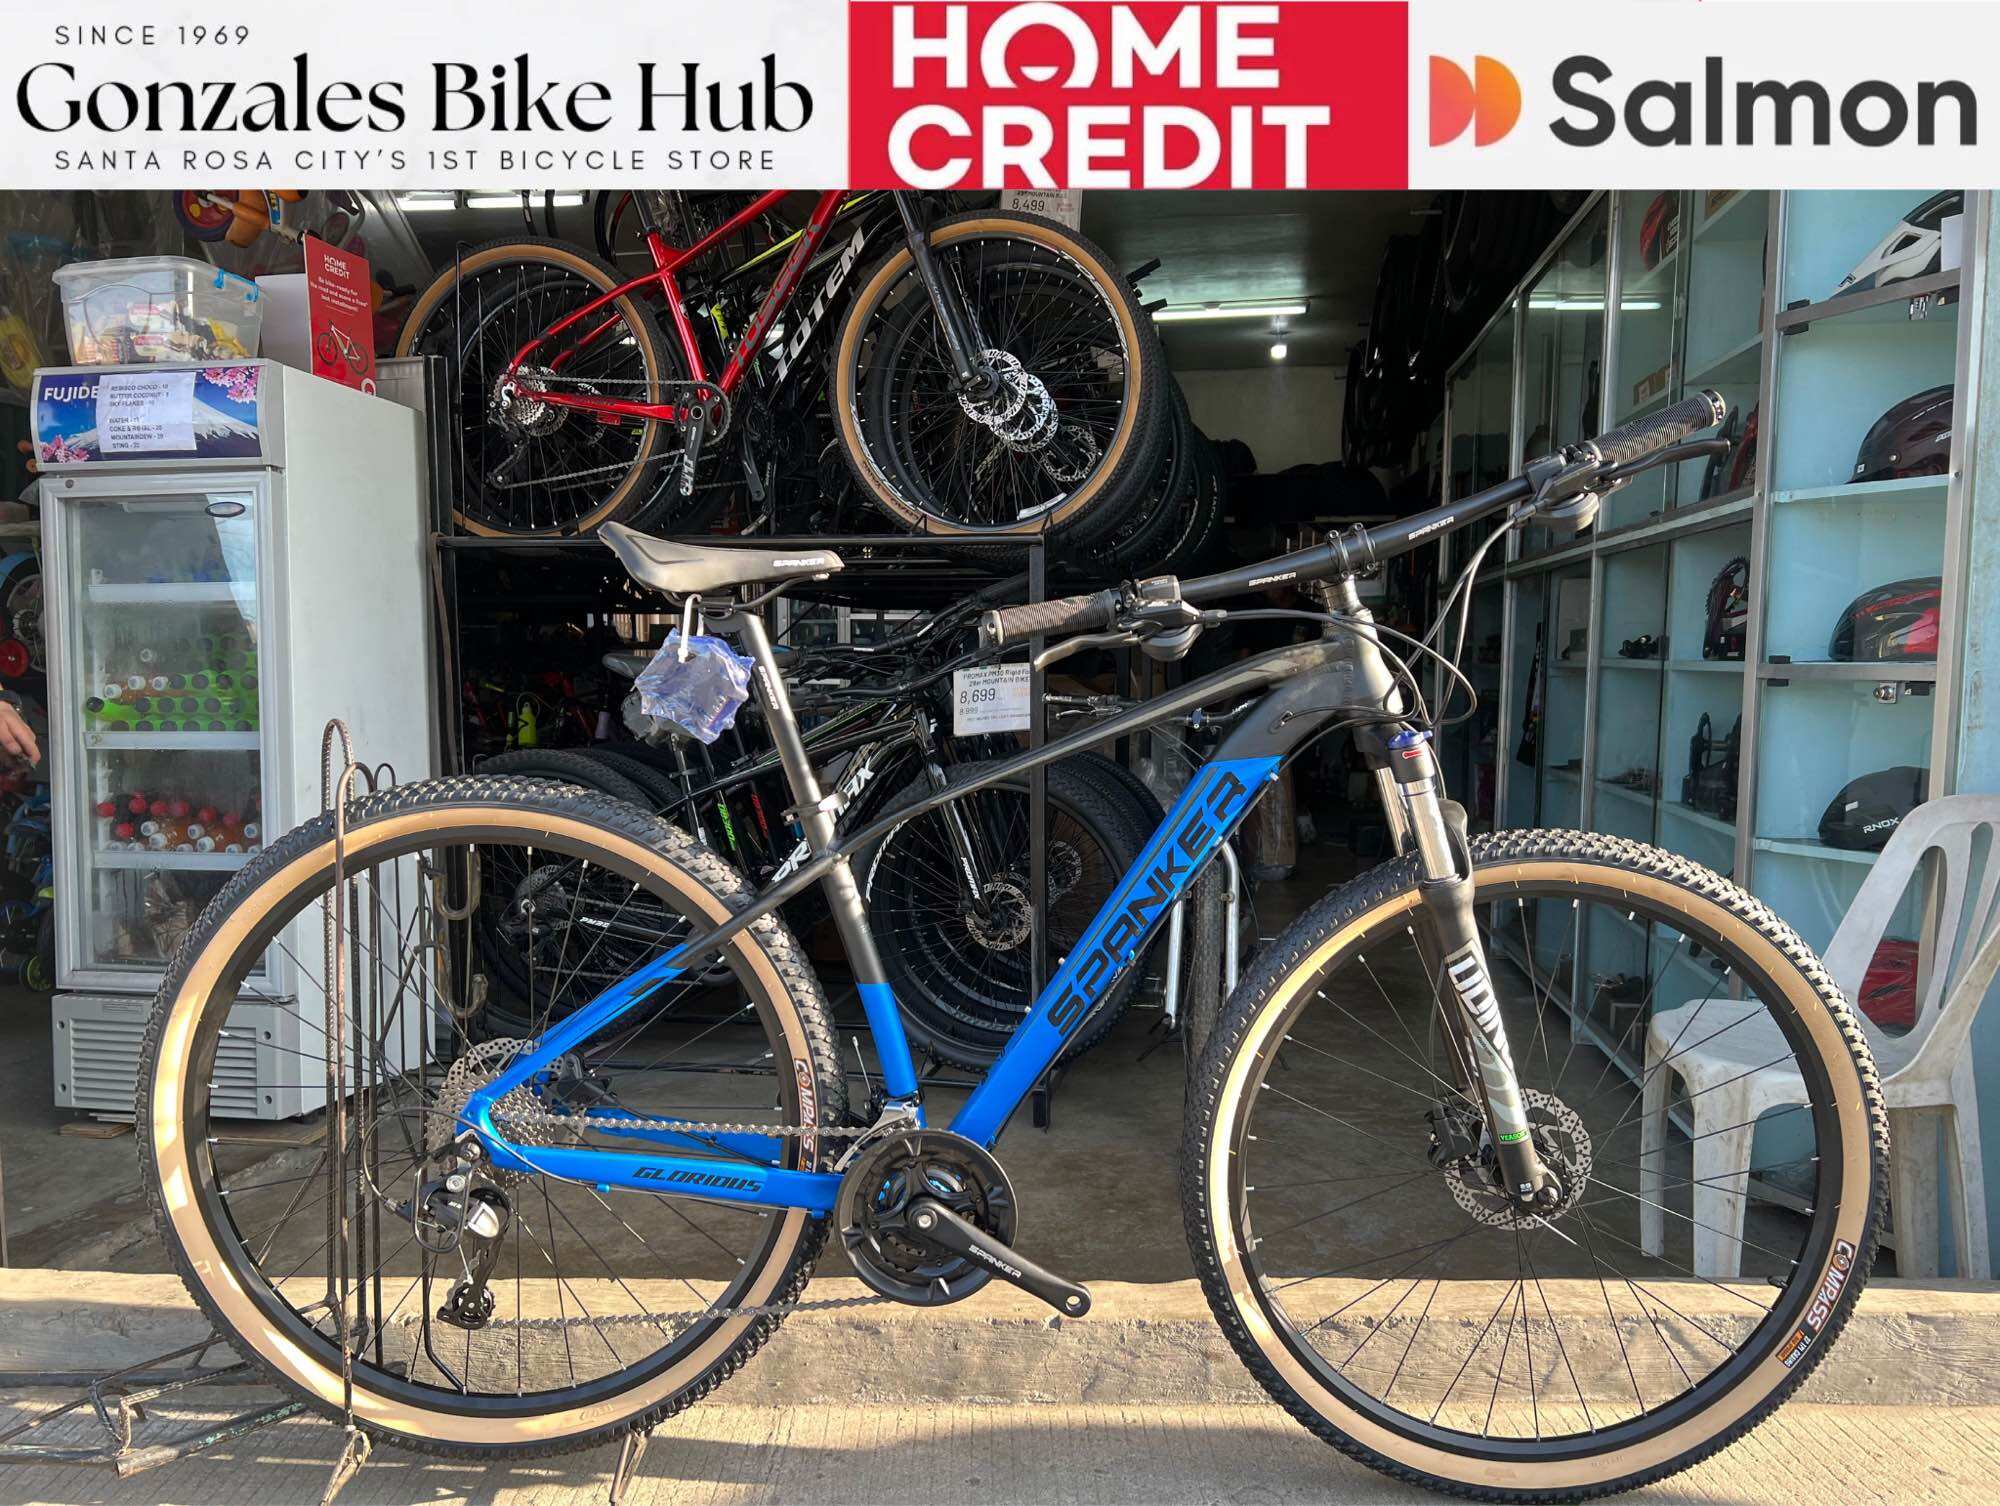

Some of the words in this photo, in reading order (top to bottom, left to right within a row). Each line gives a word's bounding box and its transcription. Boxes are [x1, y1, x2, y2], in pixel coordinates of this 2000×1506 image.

[1012, 198, 1045, 212] 8,499
[323, 253, 347, 270] HOME
[324, 263, 350, 279] CREDIT
[772, 226, 865, 383] TOTEM
[44, 384, 99, 403] FUJIDE
[1408, 515, 1455, 541] SPANKER
[1248, 571, 1297, 587] SPANKER
[758, 665, 780, 710] SPANKER
[982, 677, 1013, 685] MOUNTAIN
[960, 687, 996, 705] 8,699
[1862, 816, 1901, 834] RNOX
[960, 856, 981, 900] PROMAX
[1047, 771, 1248, 1037] SPANKER
[794, 1059, 816, 1151] COMPAS
[632, 1166, 763, 1193] GLORIOUS
[967, 1244, 1022, 1279] SPANKER
[1806, 1240, 1855, 1333] COMPASS
